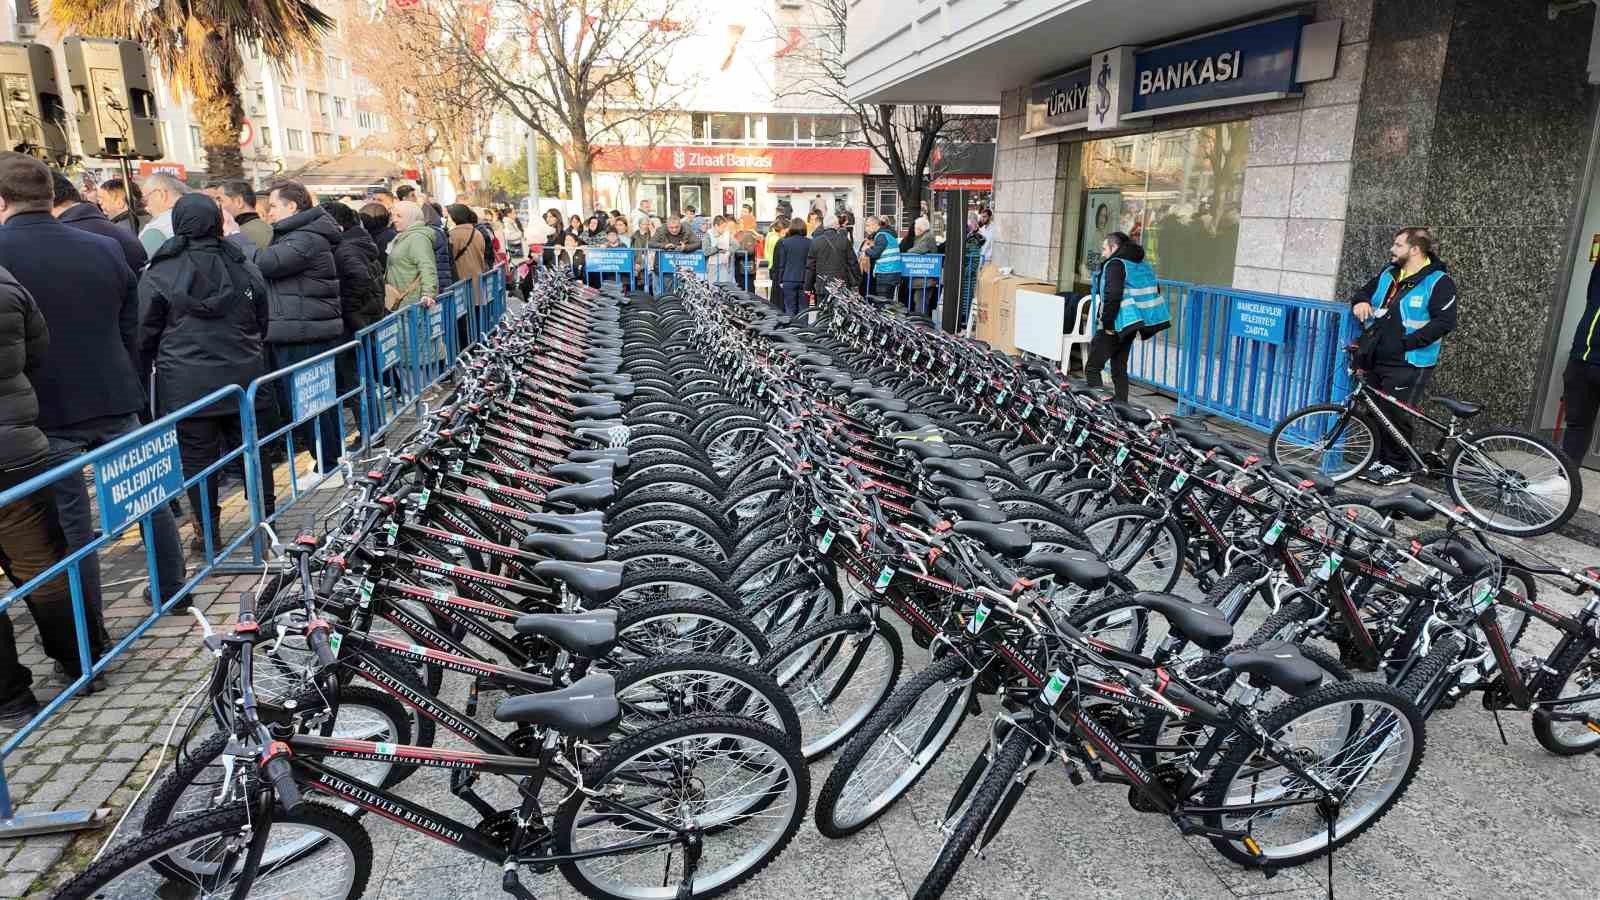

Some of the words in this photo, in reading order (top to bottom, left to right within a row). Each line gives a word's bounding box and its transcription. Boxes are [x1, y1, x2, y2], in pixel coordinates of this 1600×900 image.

[1045, 83, 1090, 116] TÜRKİY
[1139, 50, 1240, 96] BANKASI
[688, 152, 725, 167] Ziraat
[727, 153, 773, 168] Bankası
[319, 774, 402, 816] BAHÇELİEVLER
[404, 811, 464, 842] BELEDİYESİ
